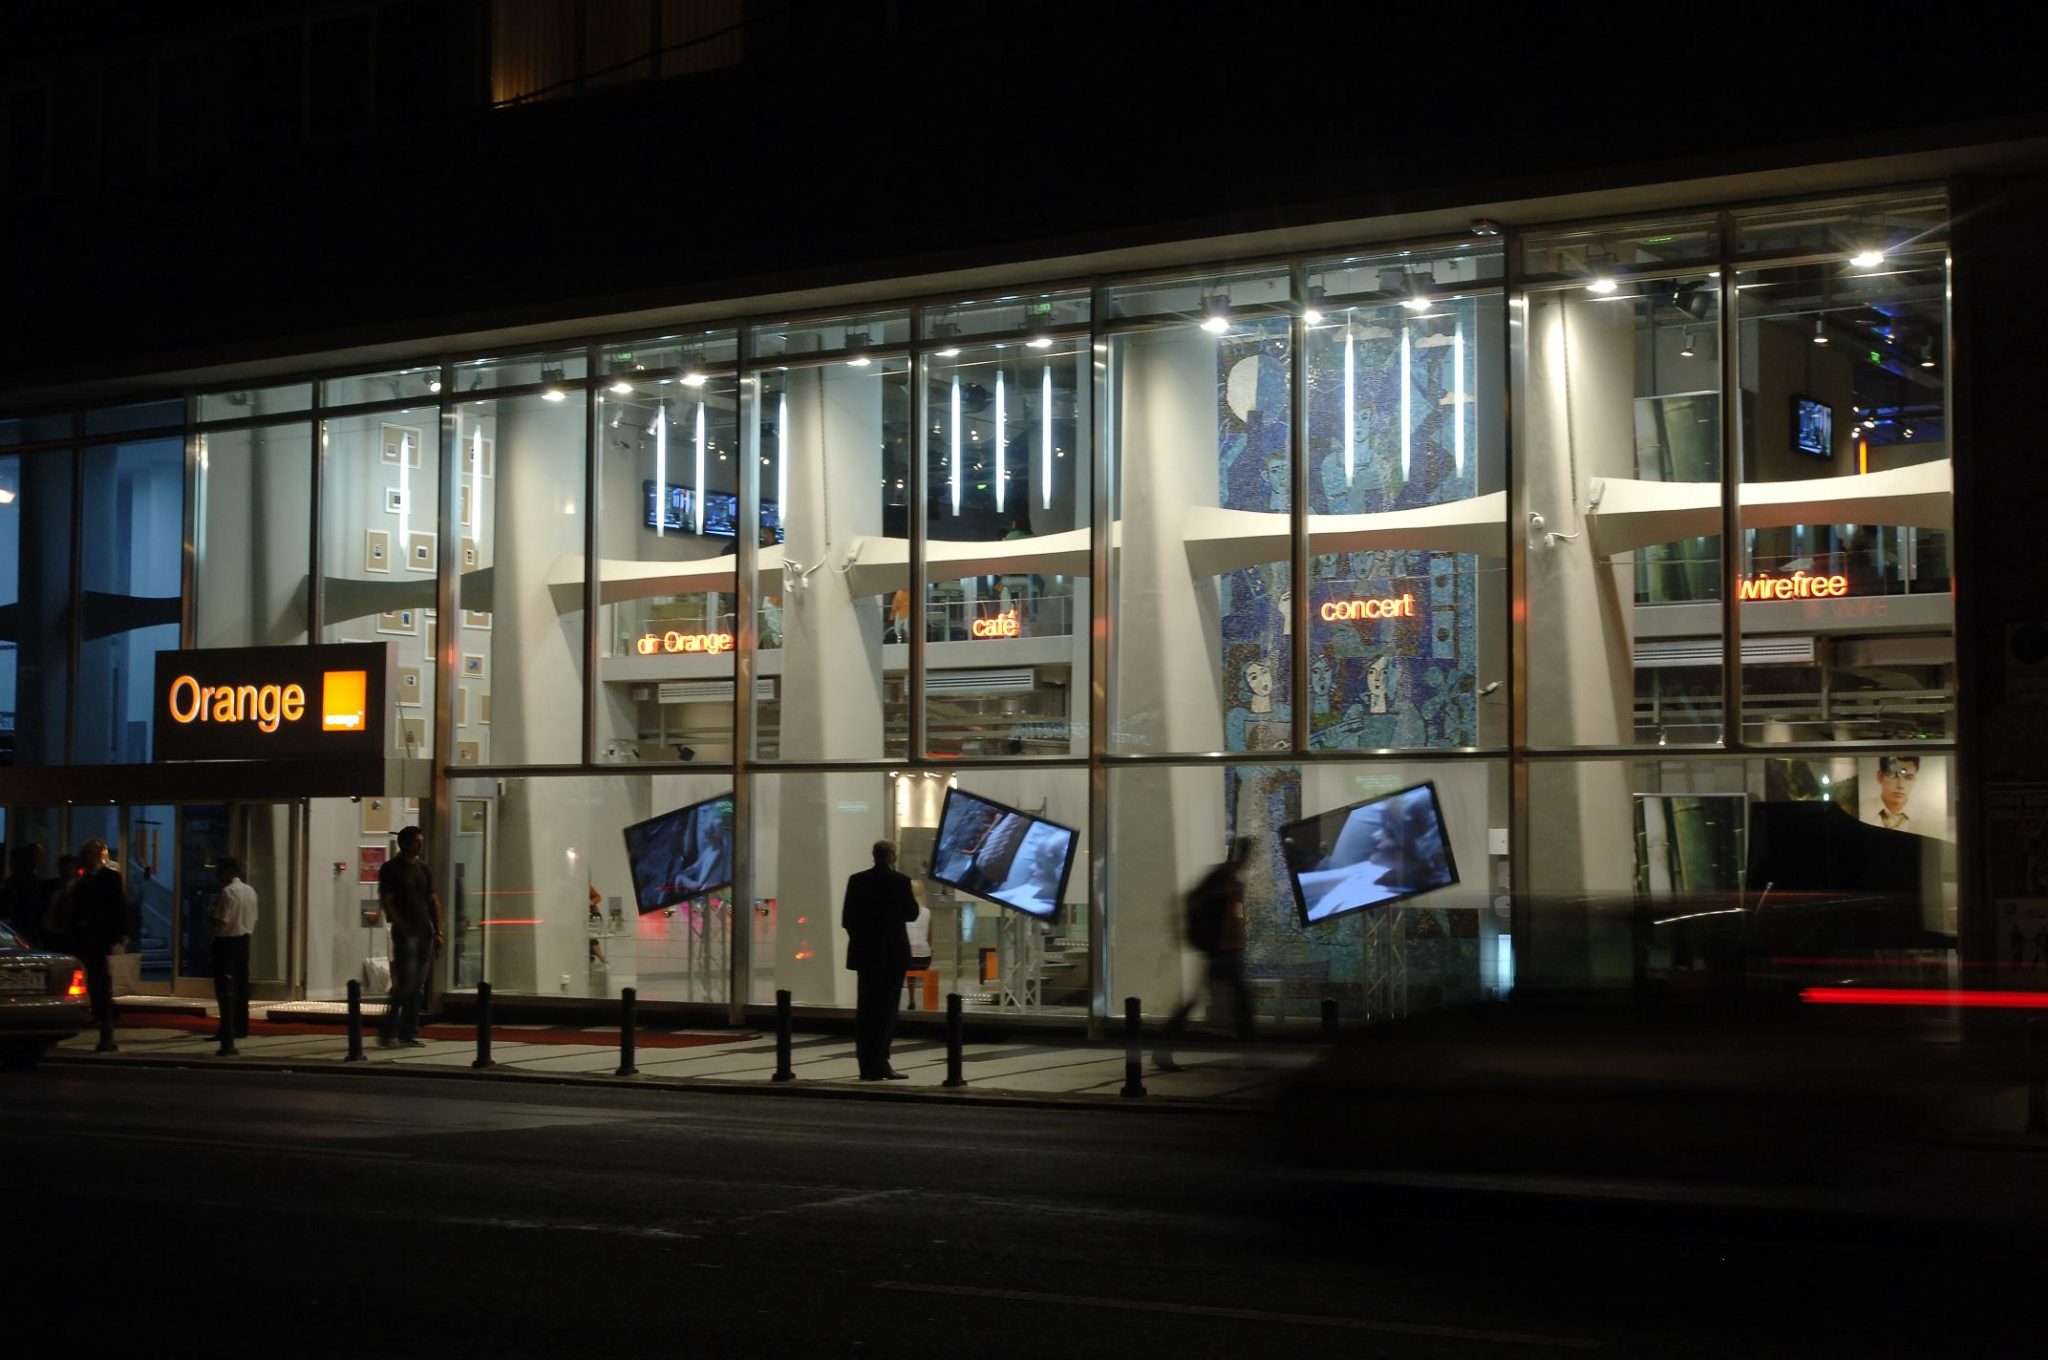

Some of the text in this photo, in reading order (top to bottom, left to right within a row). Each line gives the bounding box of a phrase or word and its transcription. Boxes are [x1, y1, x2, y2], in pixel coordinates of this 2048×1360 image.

[1739, 571, 1847, 600] wirefree
[1321, 593, 1415, 621] concert
[972, 609, 1019, 637] café
[664, 631, 733, 655] Orange
[169, 675, 305, 733] Orange
